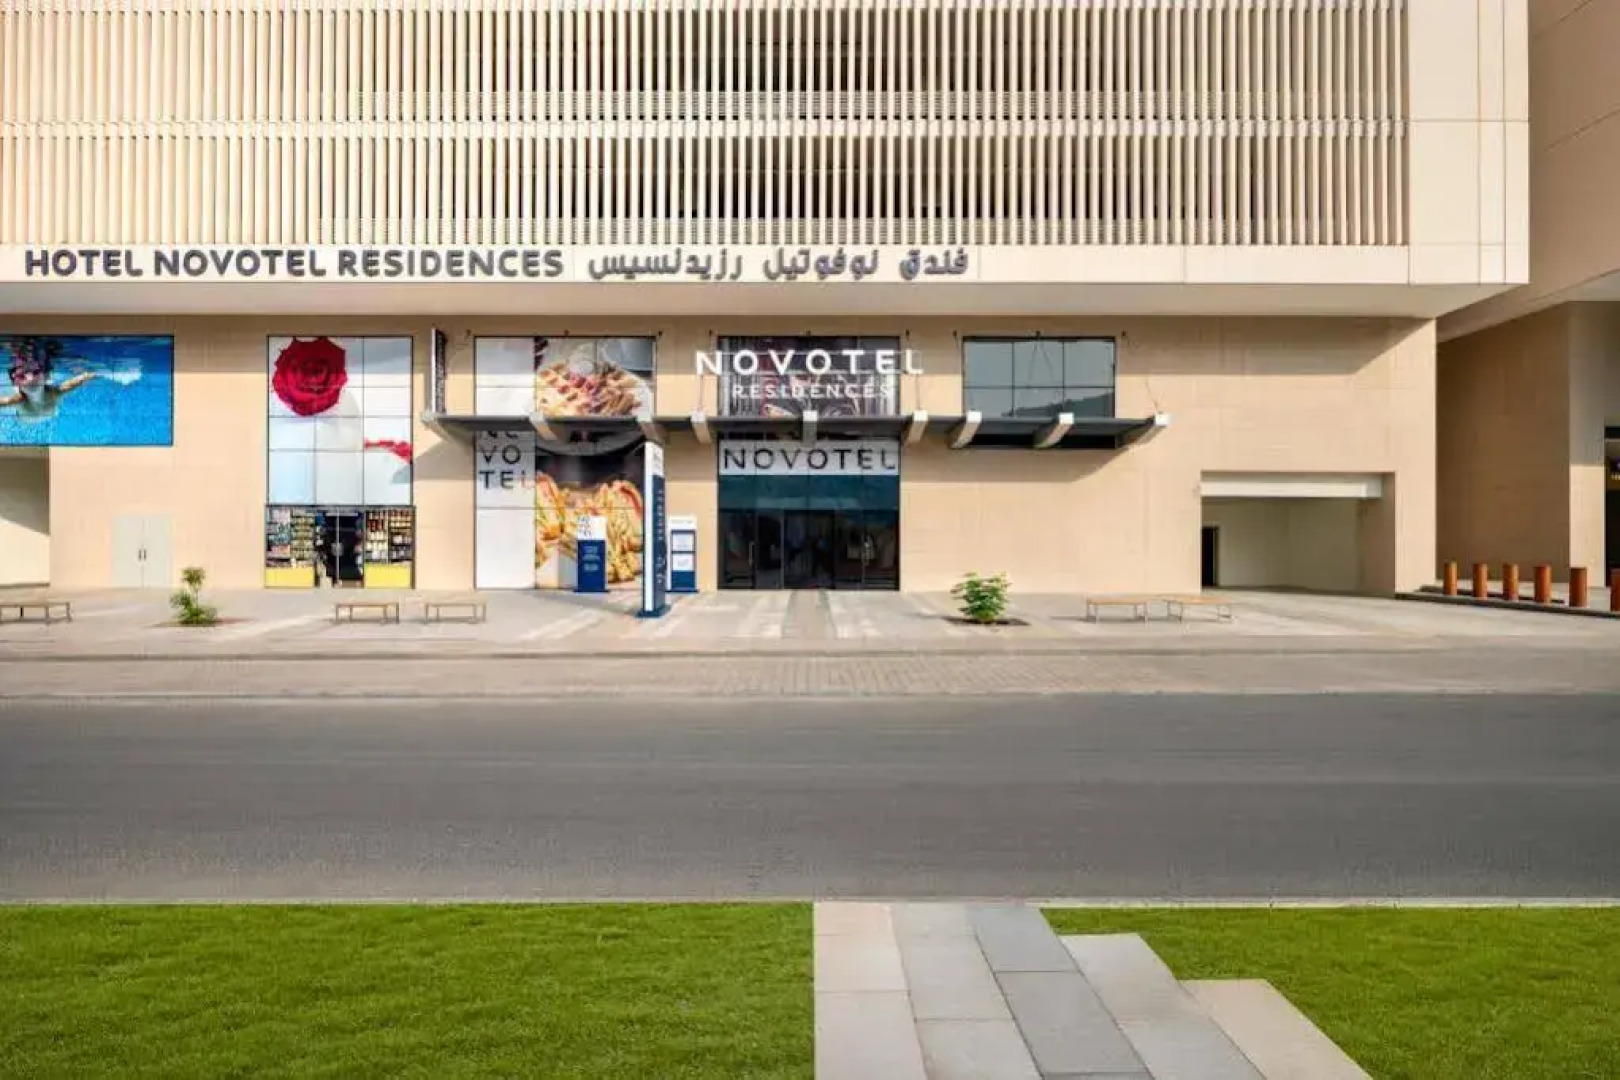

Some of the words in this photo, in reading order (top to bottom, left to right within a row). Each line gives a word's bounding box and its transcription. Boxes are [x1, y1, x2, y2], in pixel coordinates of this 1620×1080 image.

[25, 249, 143, 277] HOTEL
[154, 249, 327, 277] NOVOTEL
[338, 249, 564, 277] RESIDENCES
[588, 247, 742, 280] رزيدنسيس
[763, 247, 879, 280] نوفوتيل
[899, 247, 969, 280] فندق
[695, 349, 924, 375] NOVOTEL
[732, 384, 890, 399] RESIDENCES
[723, 448, 896, 471] NOVOTEL
